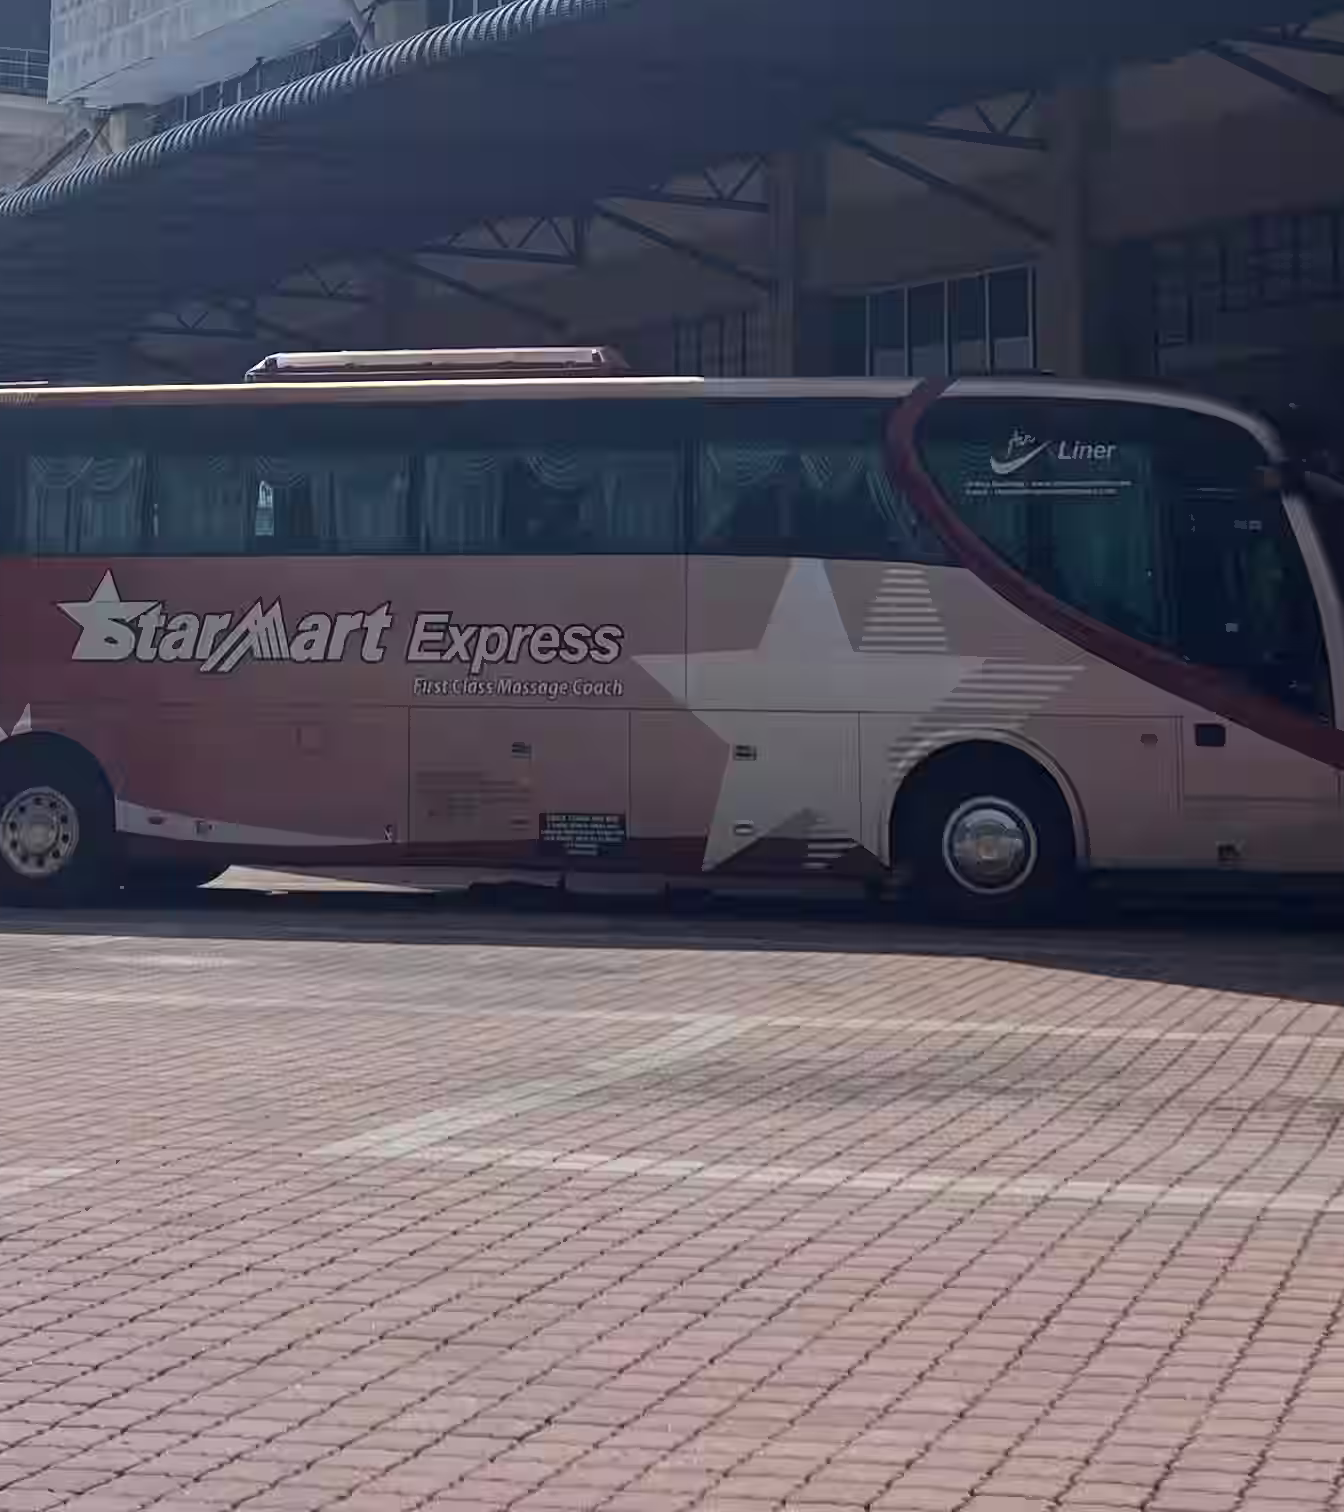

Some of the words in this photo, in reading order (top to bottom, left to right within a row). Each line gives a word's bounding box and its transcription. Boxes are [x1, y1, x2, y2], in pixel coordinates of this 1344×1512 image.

[1057, 440, 1117, 460] Liner
[406, 611, 624, 675] Express
[413, 677, 449, 695] First
[452, 677, 494, 695] Class
[496, 678, 568, 700] Massage
[572, 678, 624, 696] Coach
